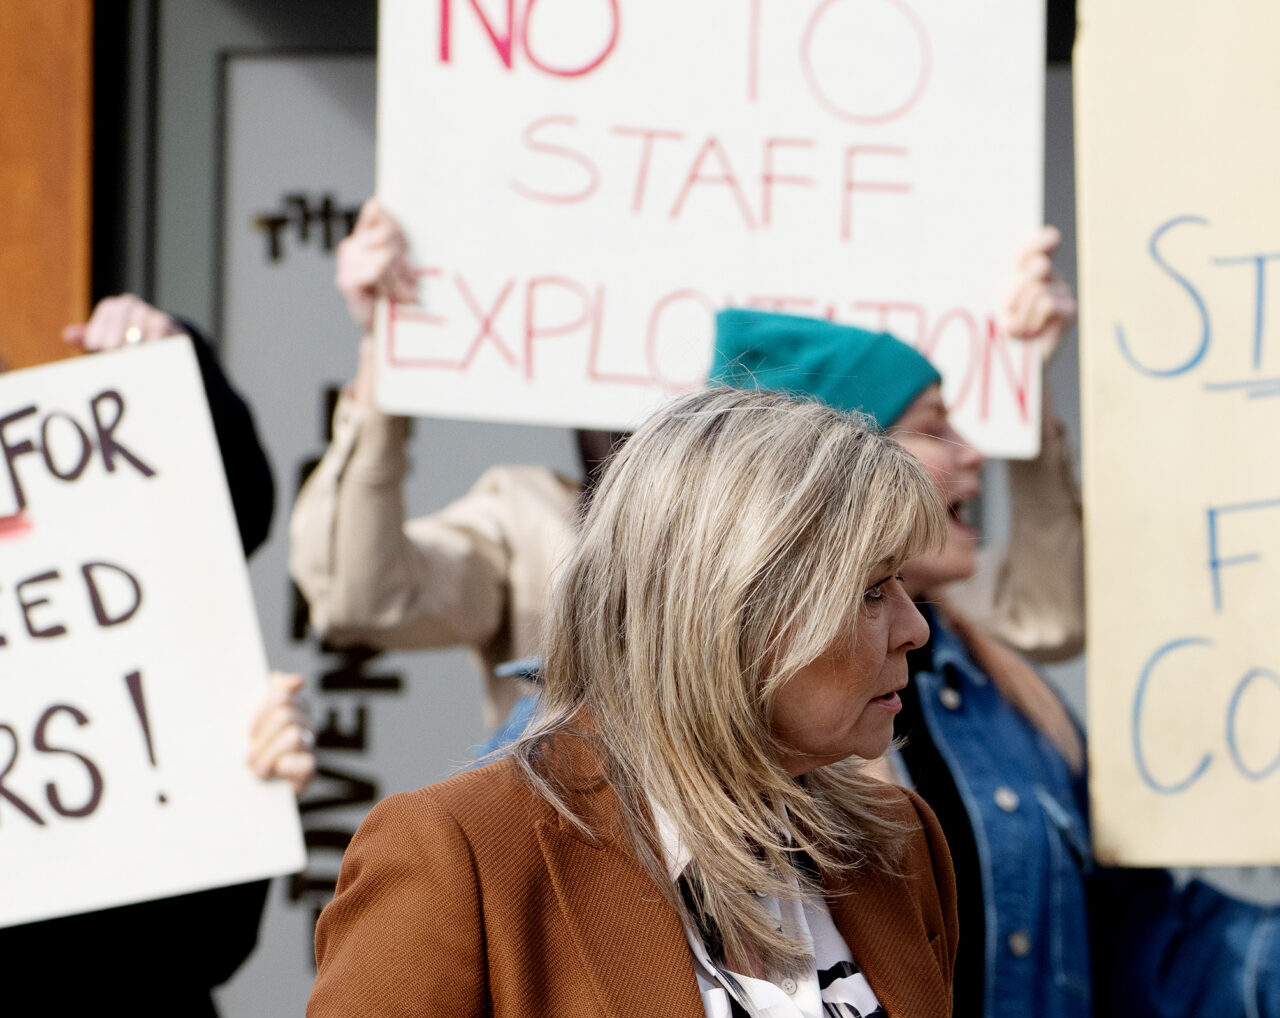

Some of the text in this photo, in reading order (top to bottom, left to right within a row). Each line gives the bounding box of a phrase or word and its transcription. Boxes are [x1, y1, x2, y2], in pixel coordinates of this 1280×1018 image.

[437, 0, 622, 78] NO
[508, 114, 915, 243] STAFF
[0, 388, 156, 514] FOR
[0, 560, 142, 646] ED
